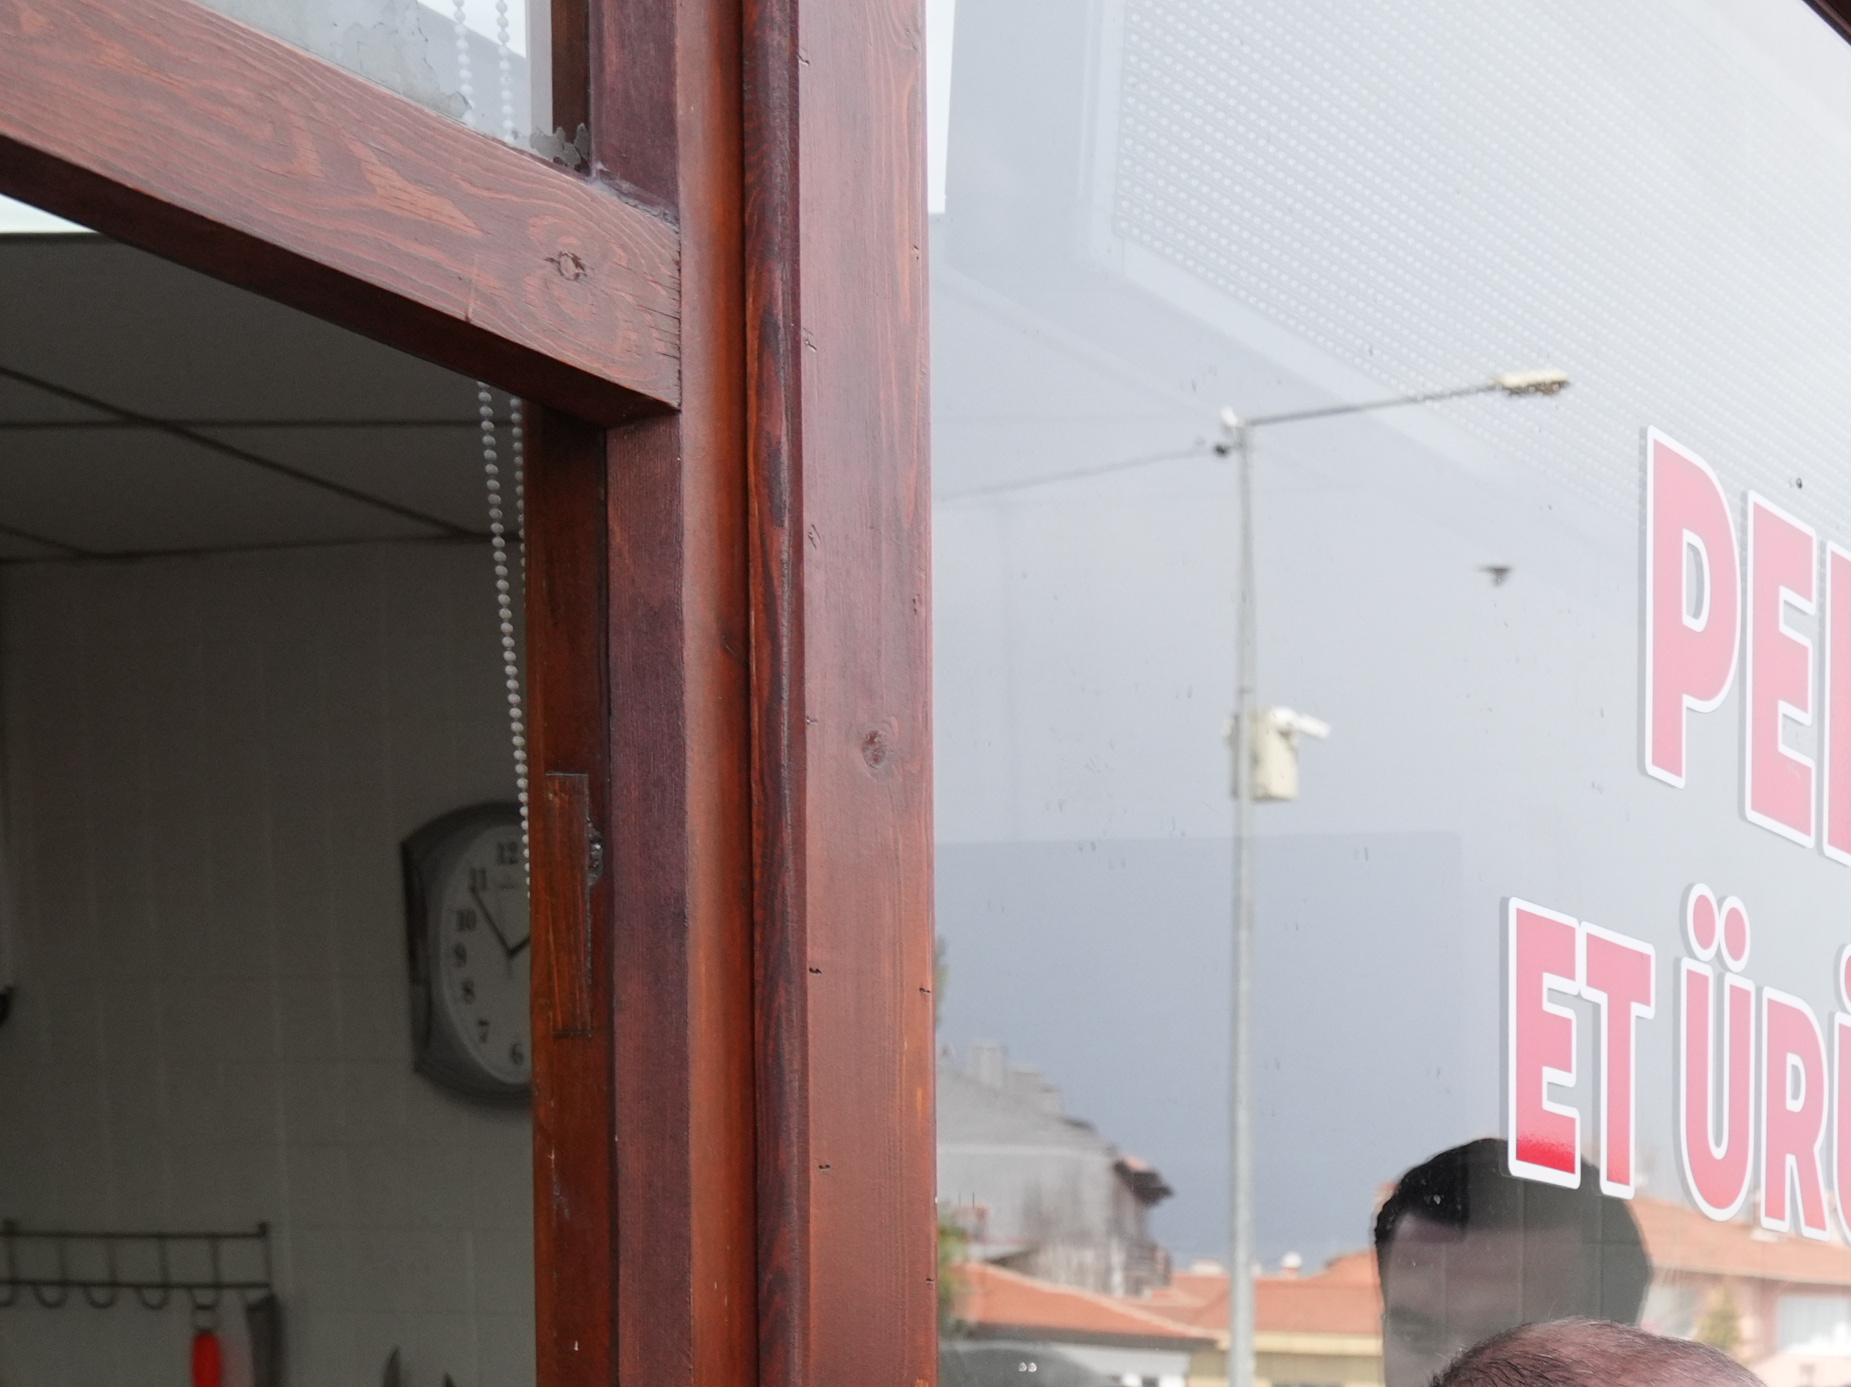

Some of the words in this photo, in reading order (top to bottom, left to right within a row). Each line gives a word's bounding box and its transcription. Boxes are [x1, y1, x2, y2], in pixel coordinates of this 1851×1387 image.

[495, 840, 519, 866] 12
[455, 908, 478, 932] 10
[477, 1018, 490, 1044] 7
[509, 1042, 524, 1066] 6
[1506, 896, 1656, 1199] ET
